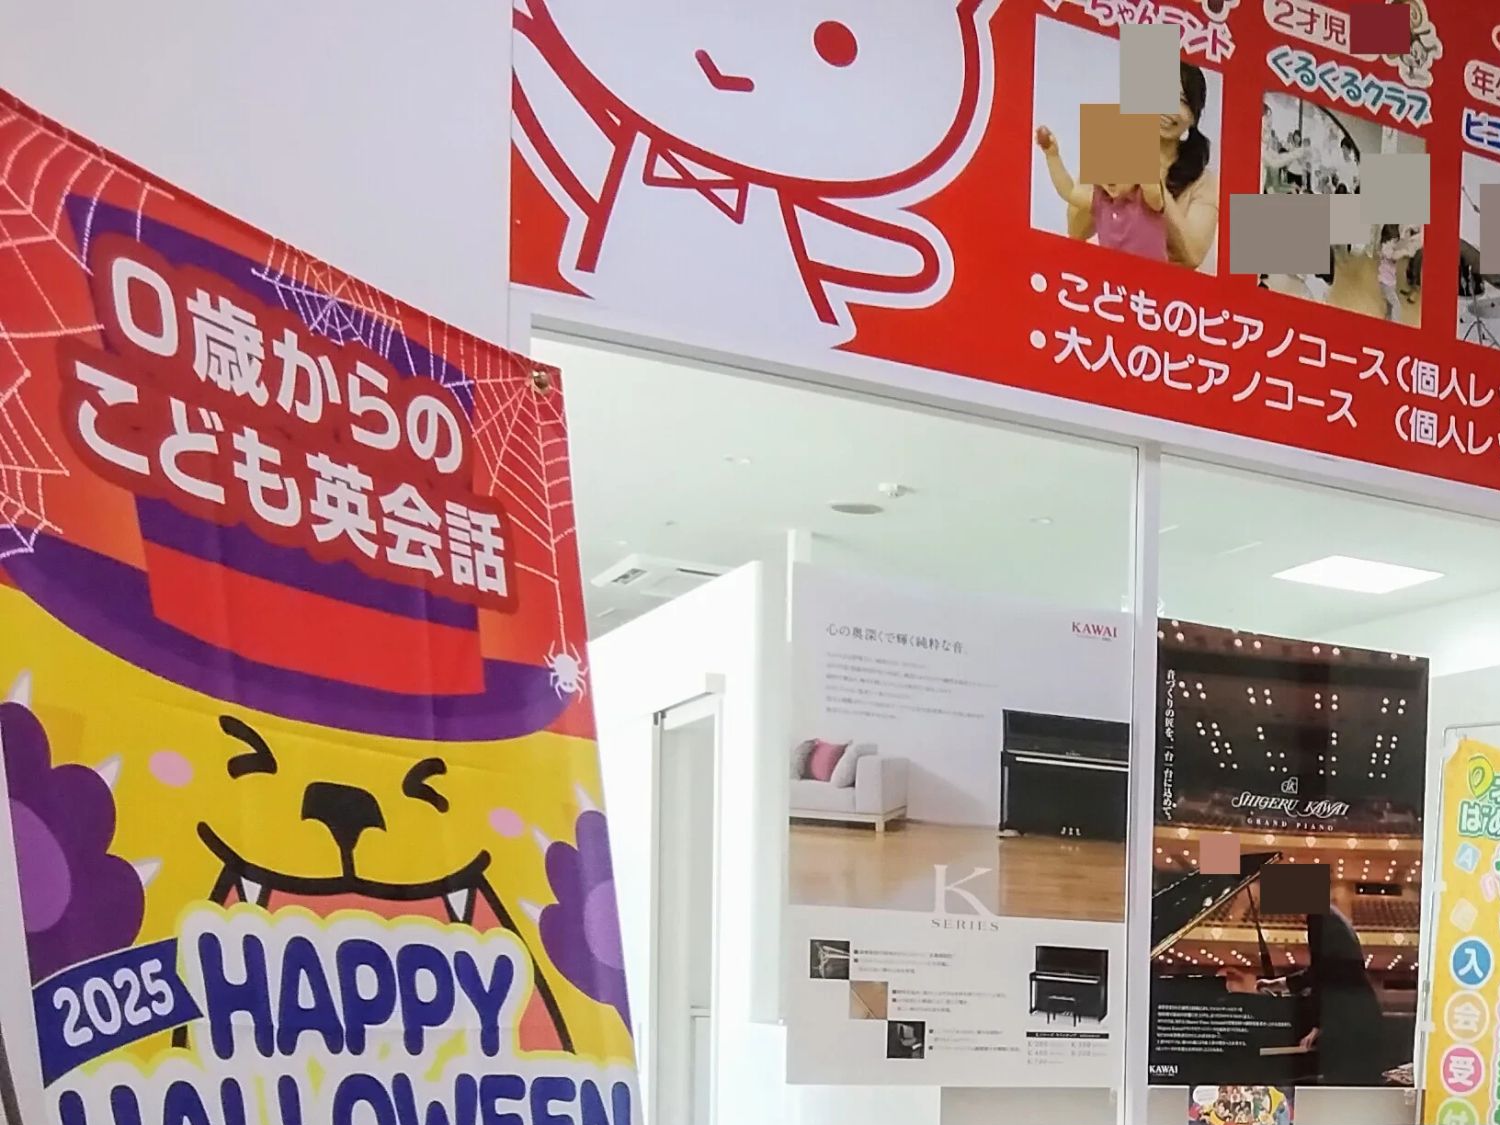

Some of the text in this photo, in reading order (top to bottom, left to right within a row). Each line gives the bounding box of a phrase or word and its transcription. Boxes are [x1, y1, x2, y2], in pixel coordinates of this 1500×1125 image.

[111, 257, 463, 474] 0歳からの
[75, 361, 509, 596] こども英会話
[1072, 621, 1118, 638] KAWAI
[1231, 791, 1350, 818] SHIGERU KAWAI
[1247, 818, 1334, 832] GRAND PIANO
[934, 864, 998, 916] K
[931, 919, 999, 931] SERIES
[53, 932, 514, 1059] 2025 HAPPY
[1149, 1065, 1178, 1074] KAWAI
